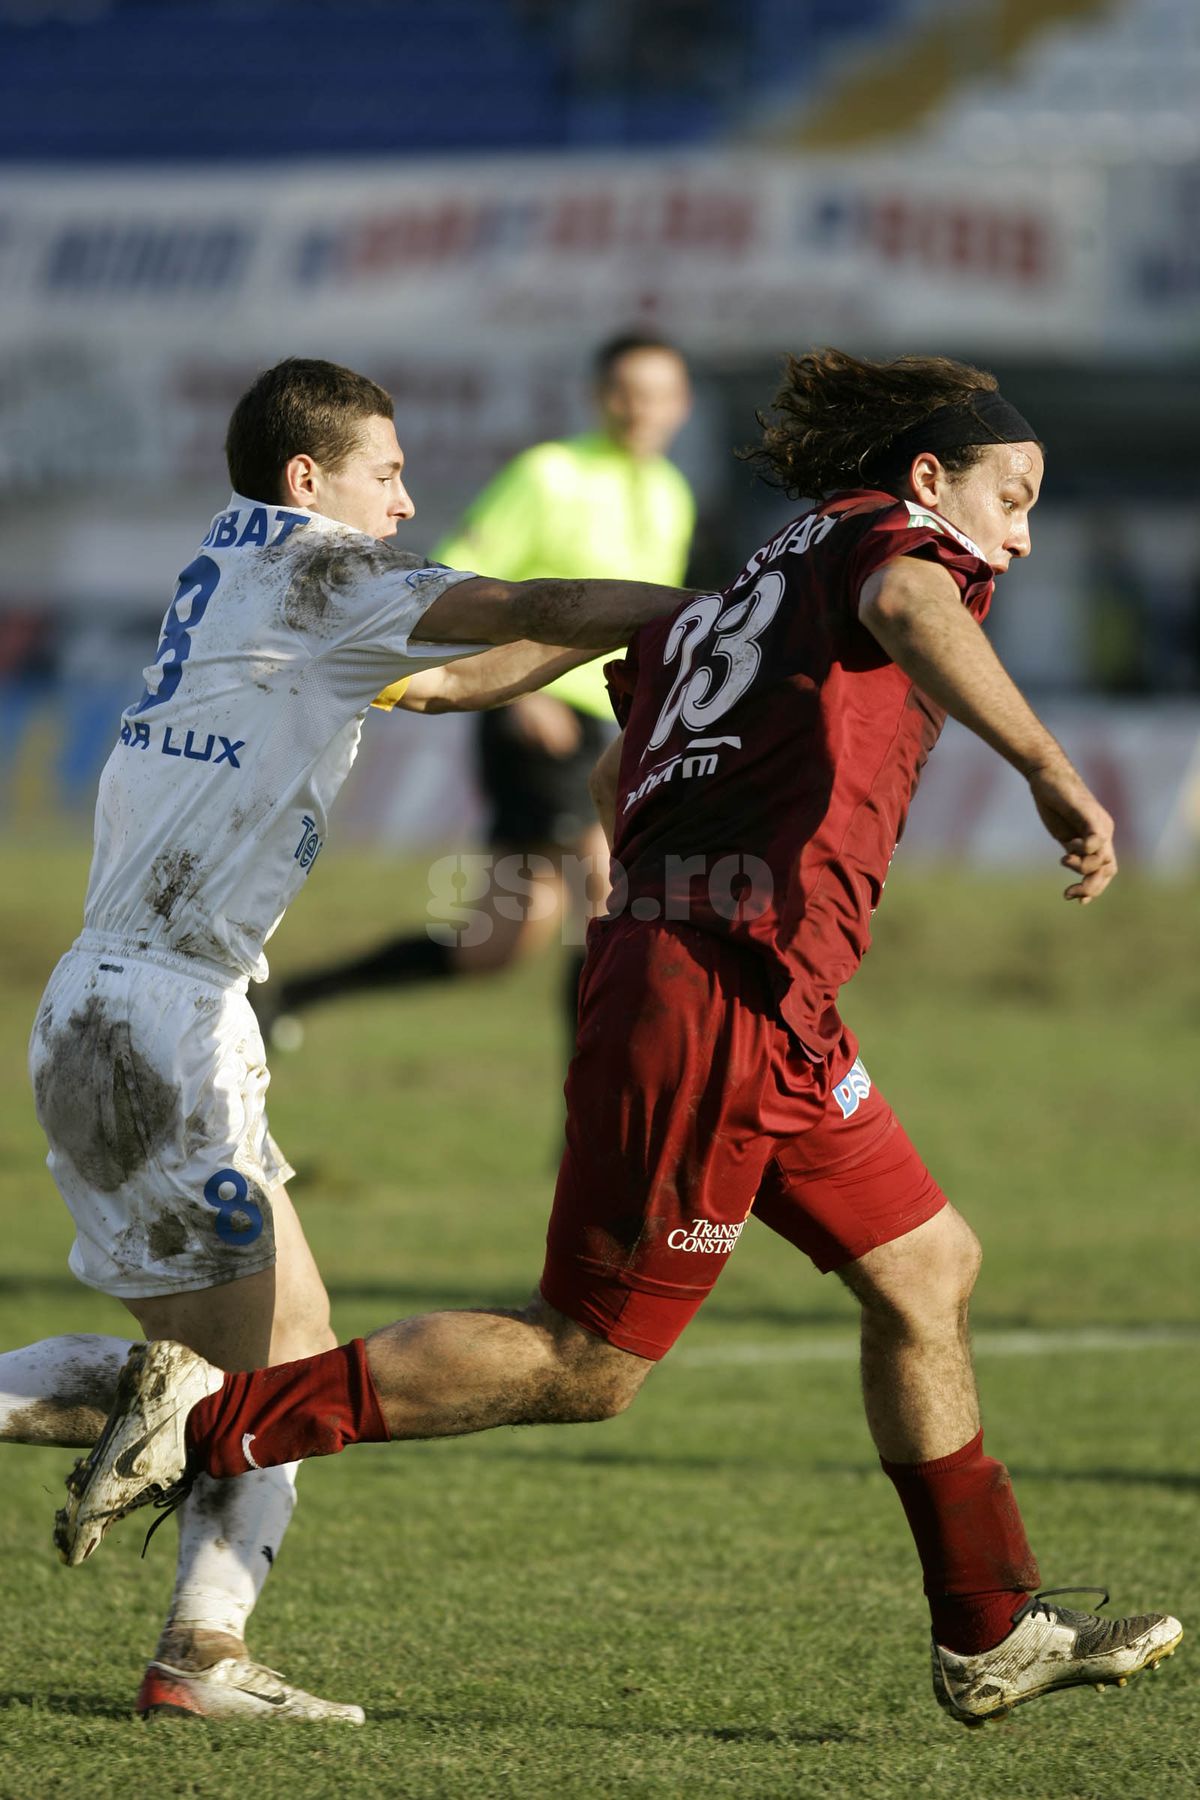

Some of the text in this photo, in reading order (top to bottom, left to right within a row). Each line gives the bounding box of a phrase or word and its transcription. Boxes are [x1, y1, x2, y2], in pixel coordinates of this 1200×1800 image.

[126, 554, 222, 717] 8
[641, 571, 786, 755] 23
[162, 726, 245, 769] LUX
[204, 1168, 264, 1246] 8
